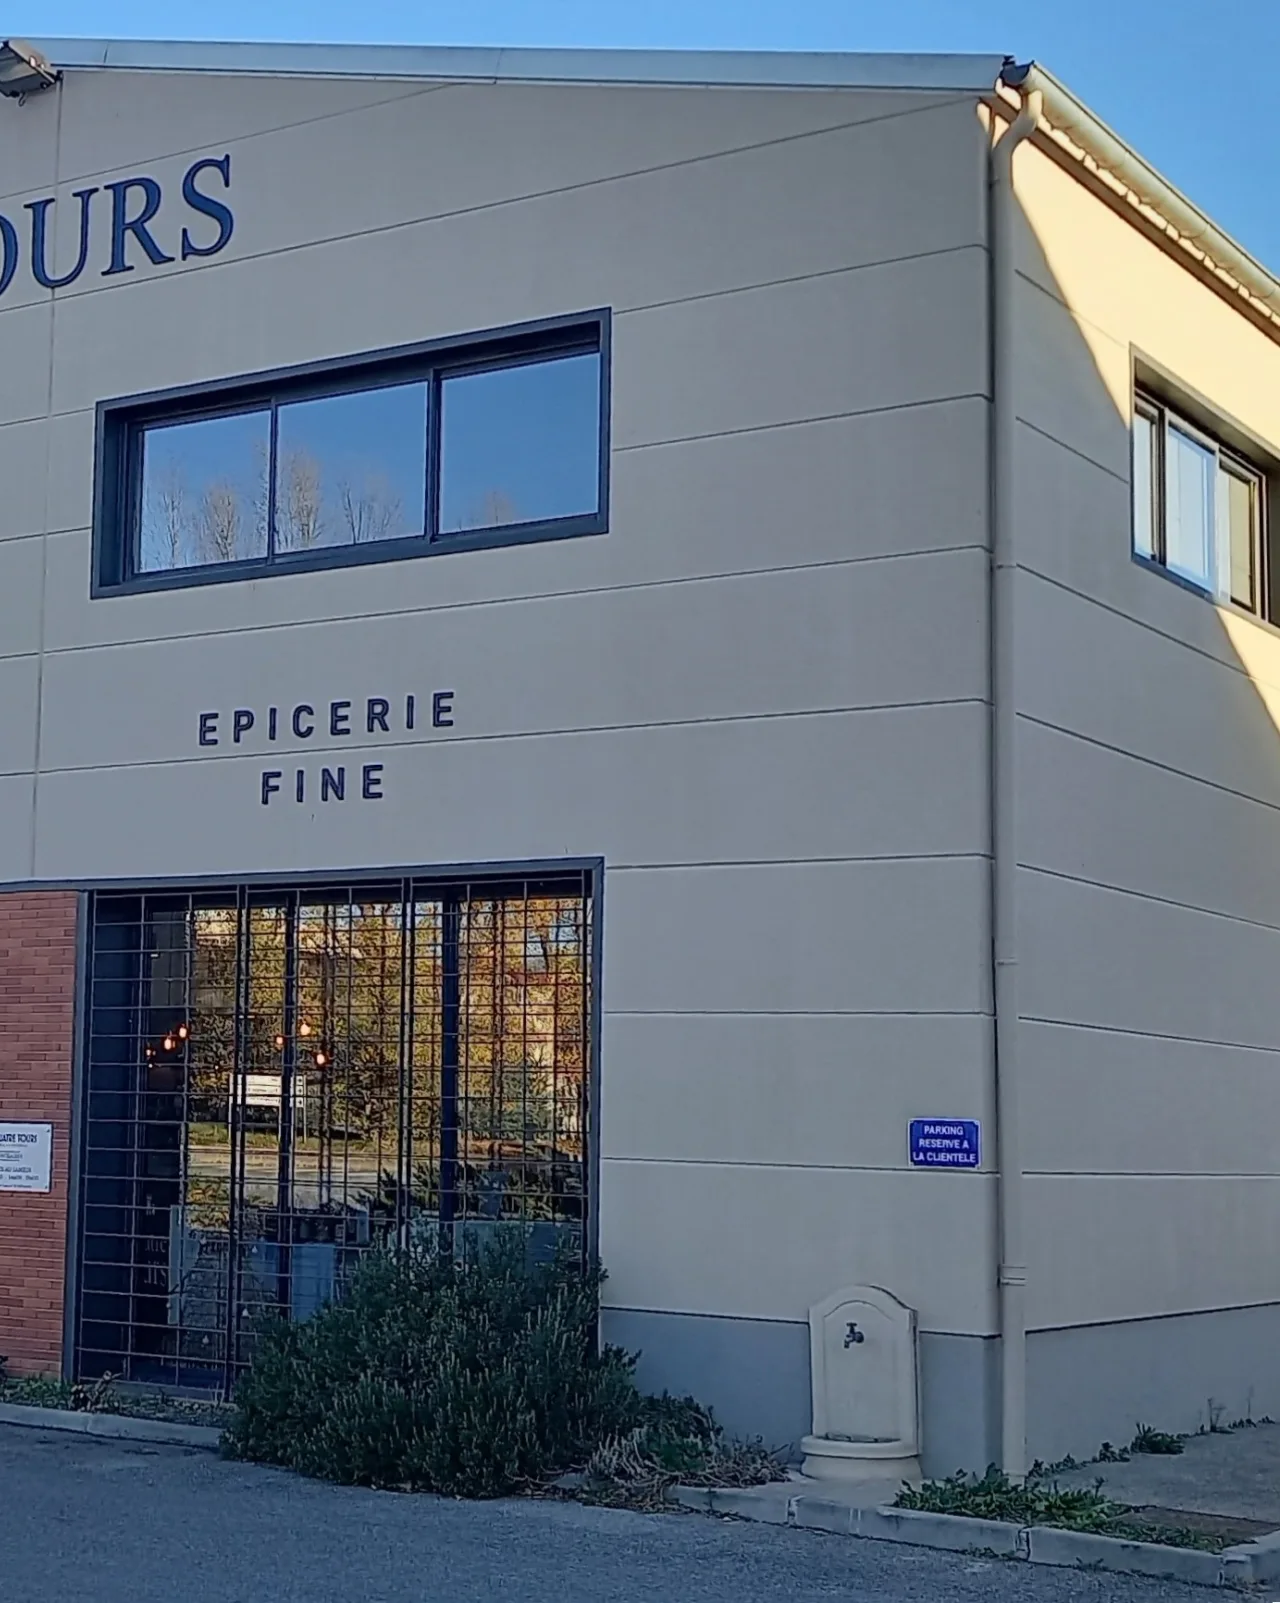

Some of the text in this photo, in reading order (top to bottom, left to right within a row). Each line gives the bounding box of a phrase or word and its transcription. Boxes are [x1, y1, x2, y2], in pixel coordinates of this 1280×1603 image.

[198, 691, 455, 746] EPICERIE
[261, 764, 384, 805] FINE
[924, 1125, 963, 1135] PARKING
[962, 1139, 969, 1149] A
[913, 1152, 976, 1162] LA CLIENTELE
